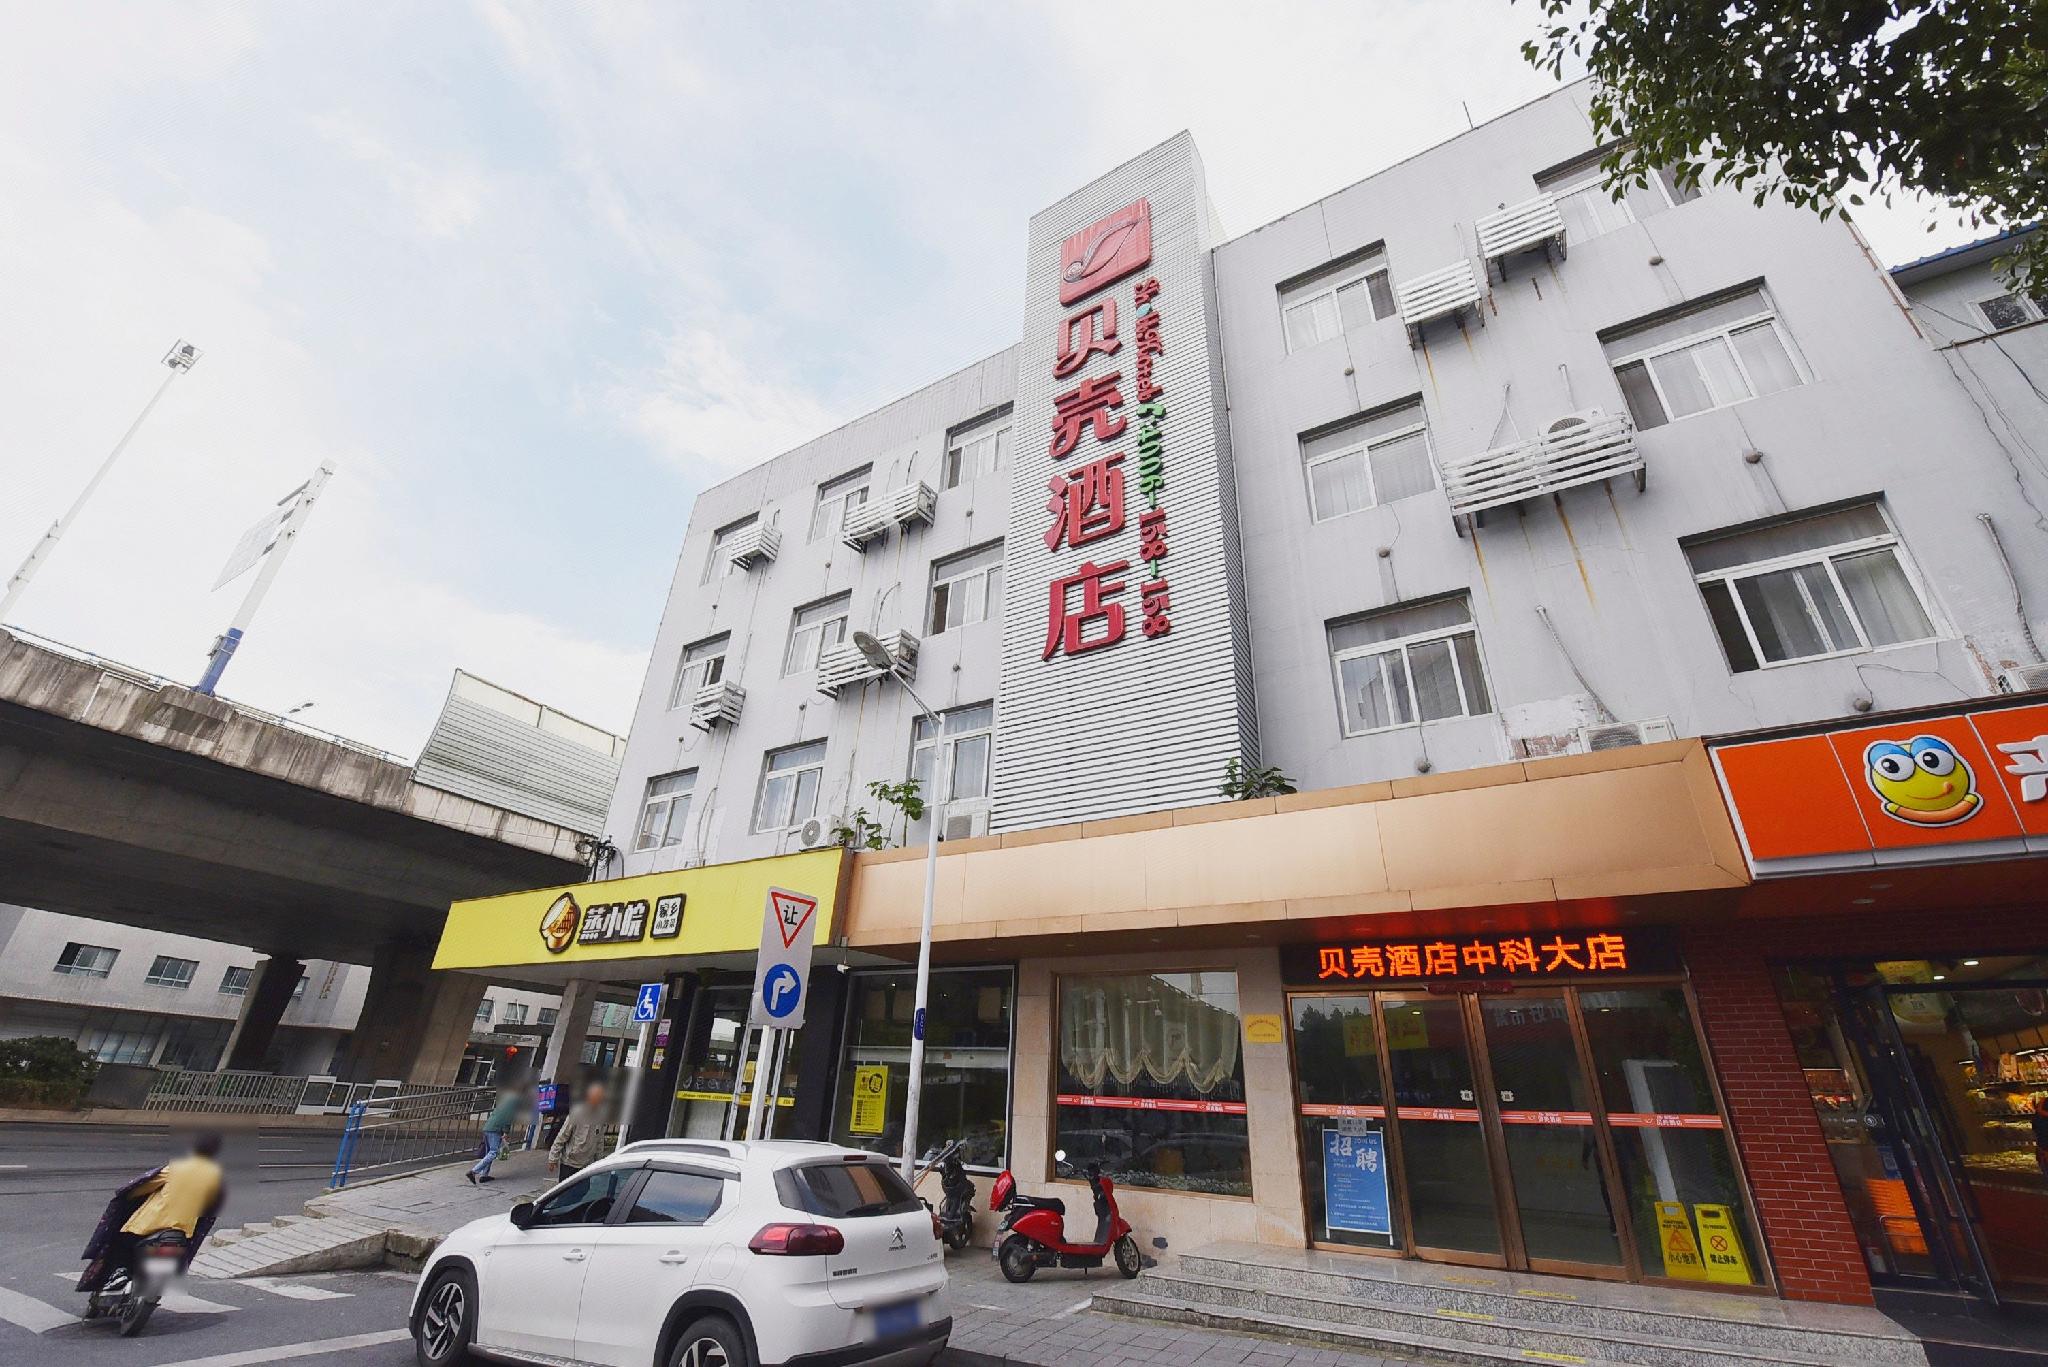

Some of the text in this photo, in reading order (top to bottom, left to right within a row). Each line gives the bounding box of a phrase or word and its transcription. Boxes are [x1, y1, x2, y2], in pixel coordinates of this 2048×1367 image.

[1042, 296, 1129, 661] 贝壳酒店
[782, 904, 800, 927] 让
[1317, 933, 1628, 980] 贝壳酒店中科大店
[1329, 1133, 1378, 1173] 招聘
